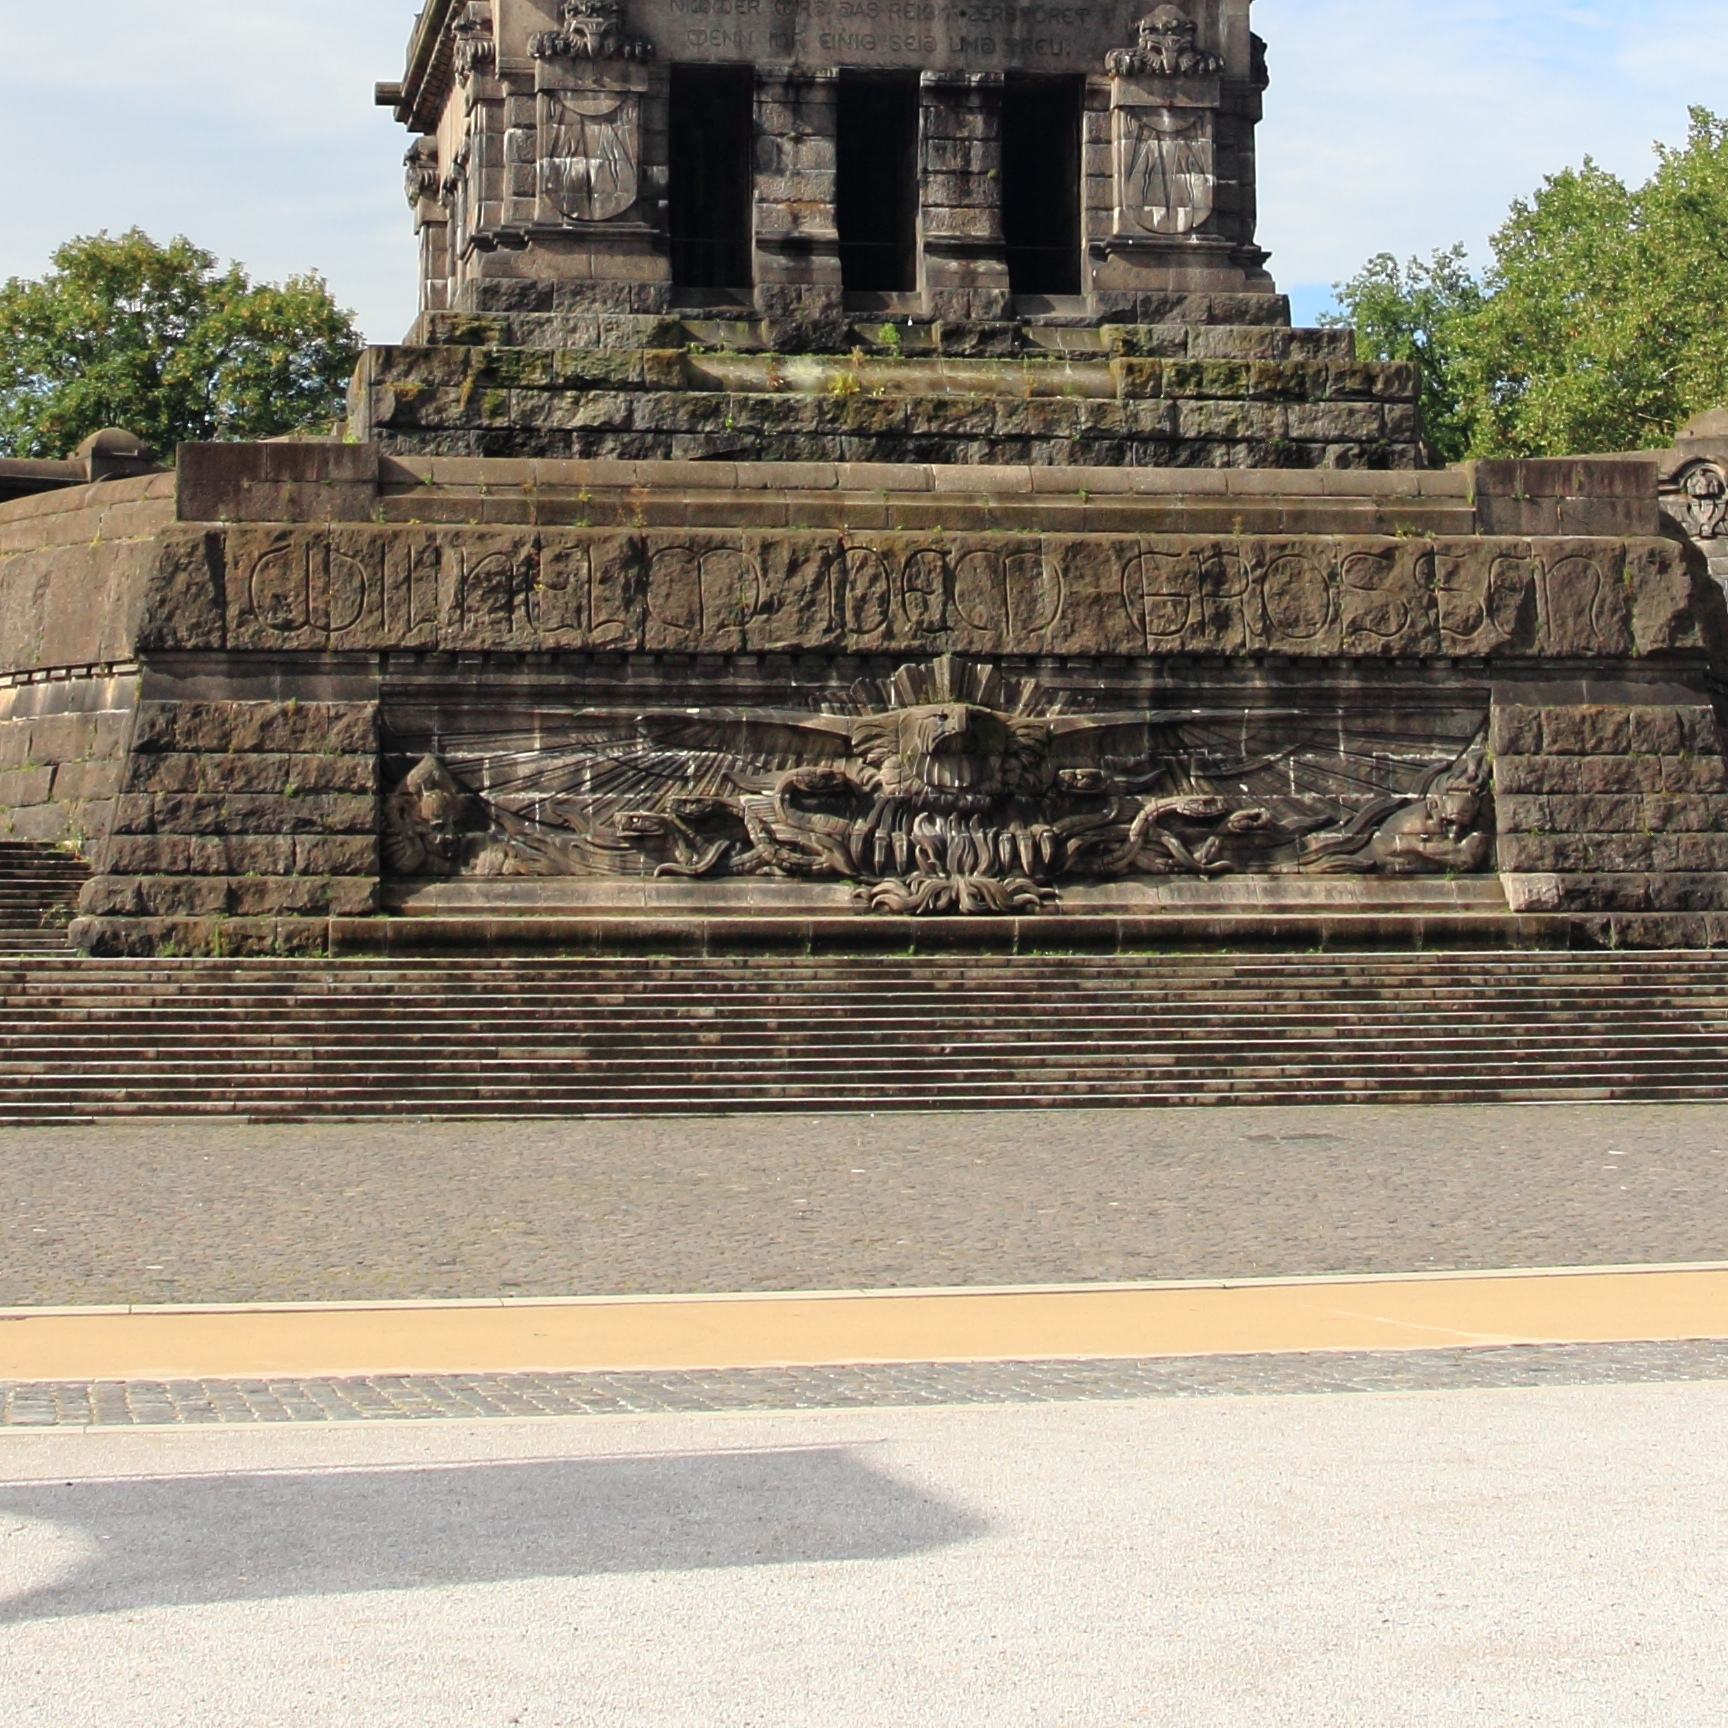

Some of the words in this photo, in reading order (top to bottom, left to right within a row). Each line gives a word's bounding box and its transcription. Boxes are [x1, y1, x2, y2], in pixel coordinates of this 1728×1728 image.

[839, 0, 881, 19] DAS
[687, 28, 754, 48] WENN
[819, 31, 877, 51] EINIG
[889, 34, 937, 52] SEID
[949, 35, 997, 54] UND
[823, 545, 1065, 638] DEM
[1120, 549, 1606, 642] GROSSEN
